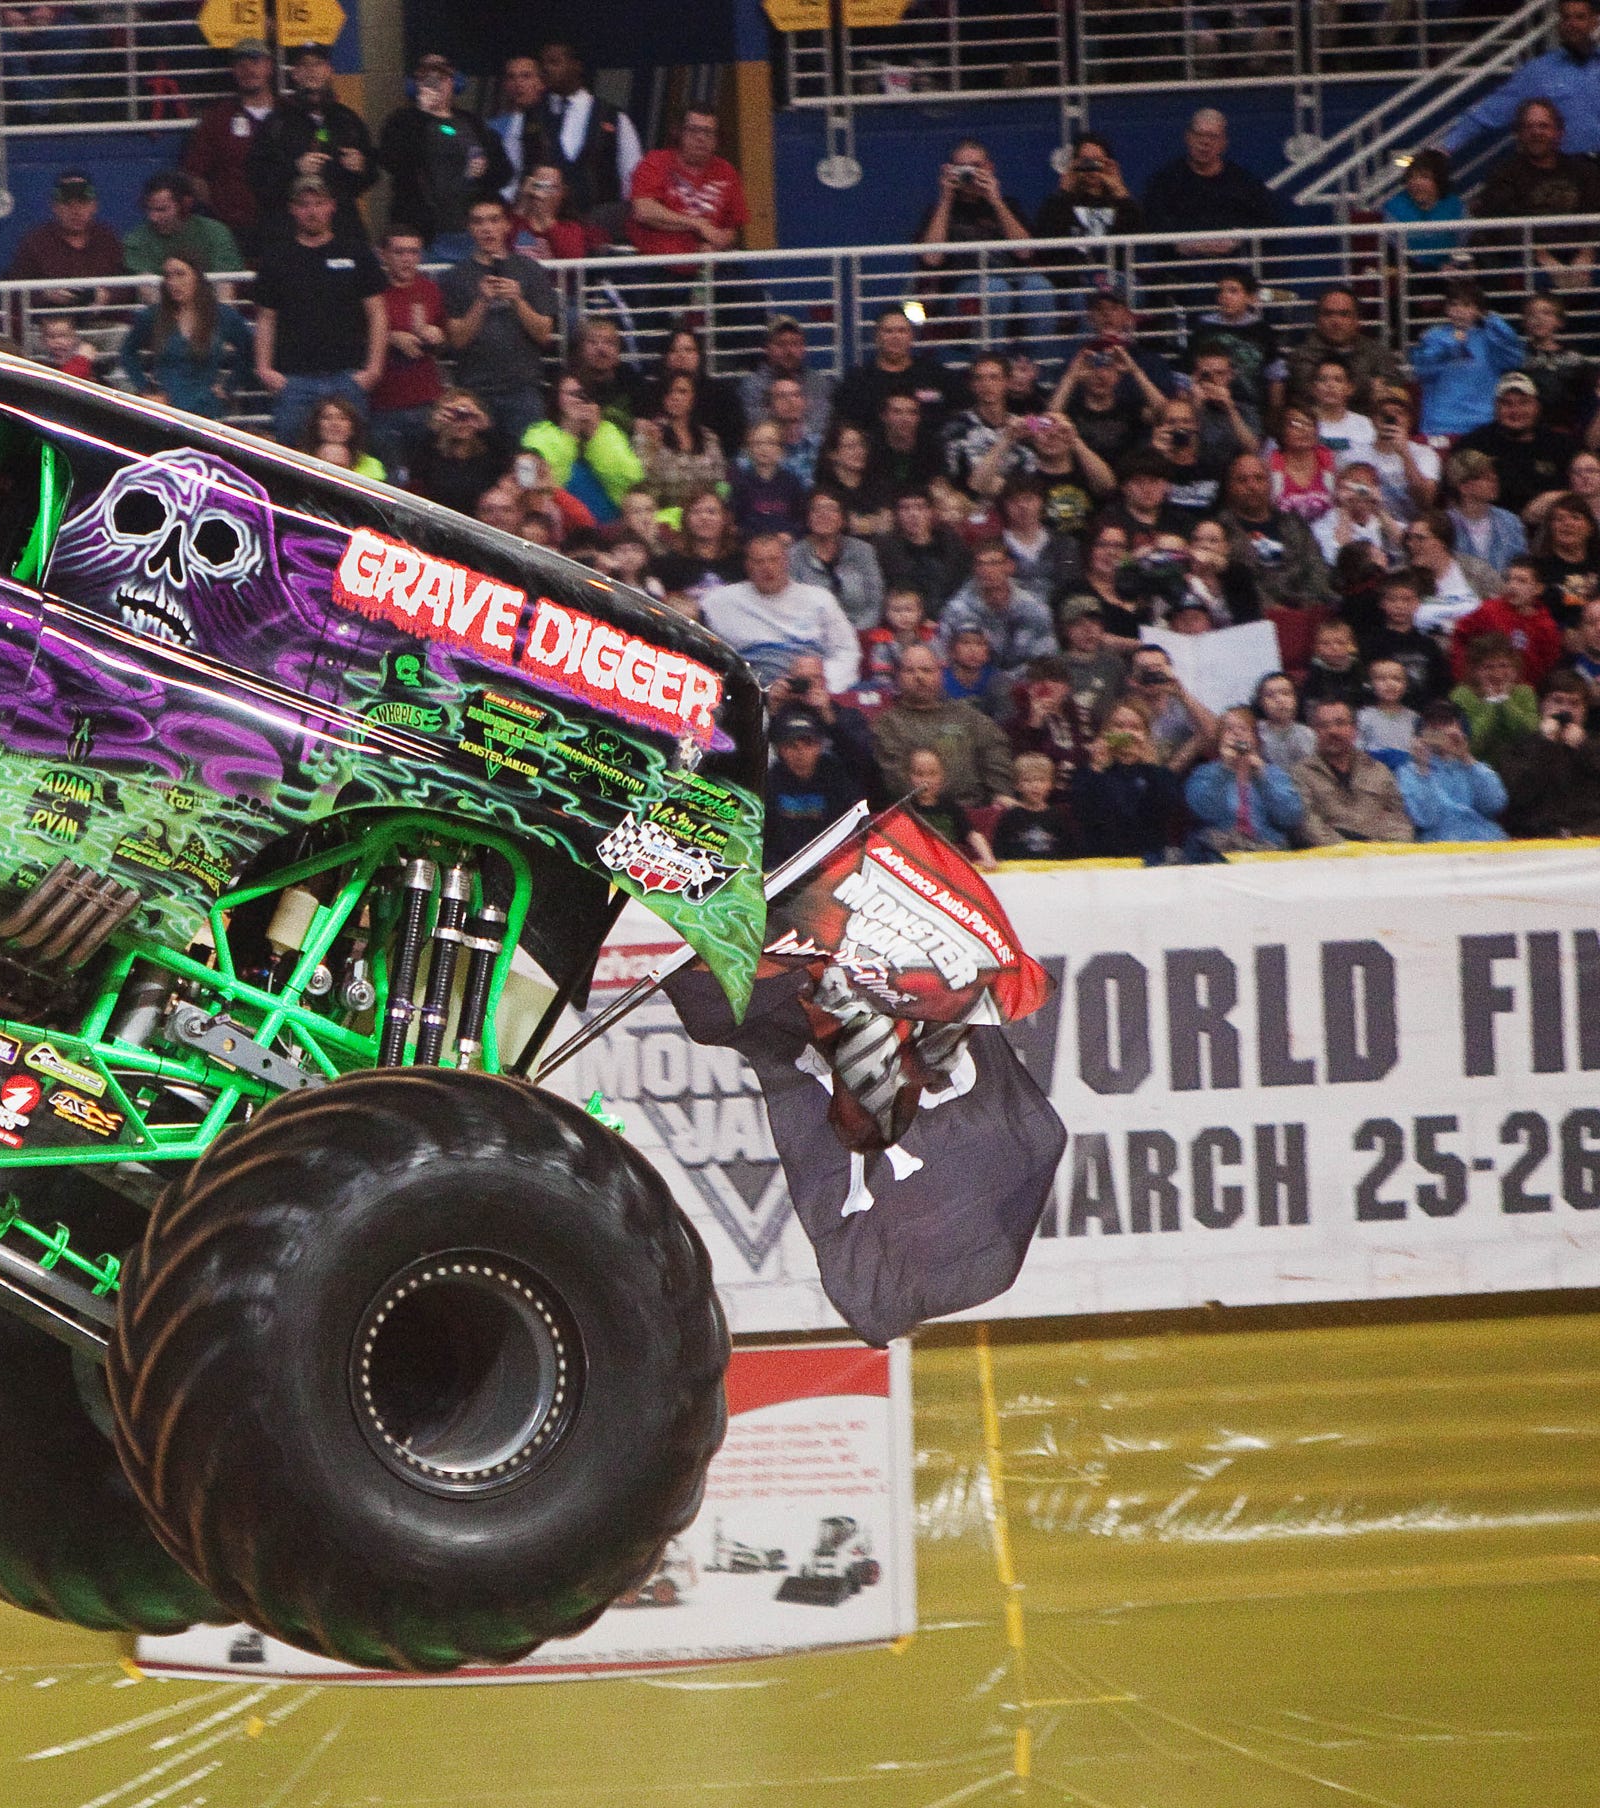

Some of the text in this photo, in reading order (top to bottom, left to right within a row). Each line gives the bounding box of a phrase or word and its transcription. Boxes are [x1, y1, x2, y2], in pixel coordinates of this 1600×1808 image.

[339, 532, 721, 727] GRAVE DIGGER
[467, 706, 547, 745] MONSTER
[484, 728, 525, 749] JAM
[459, 740, 539, 778] MONSTERJAM.COM
[39, 772, 92, 807] ADAM
[169, 789, 194, 810] taz
[29, 810, 79, 843] RYAN
[181, 851, 231, 884] AIR FORCE
[871, 845, 1003, 953] Advance Auto Parts
[833, 872, 978, 990] MONSTER
[52, 1093, 89, 1117] PAC
[1038, 1122, 1310, 1239] ARCH
